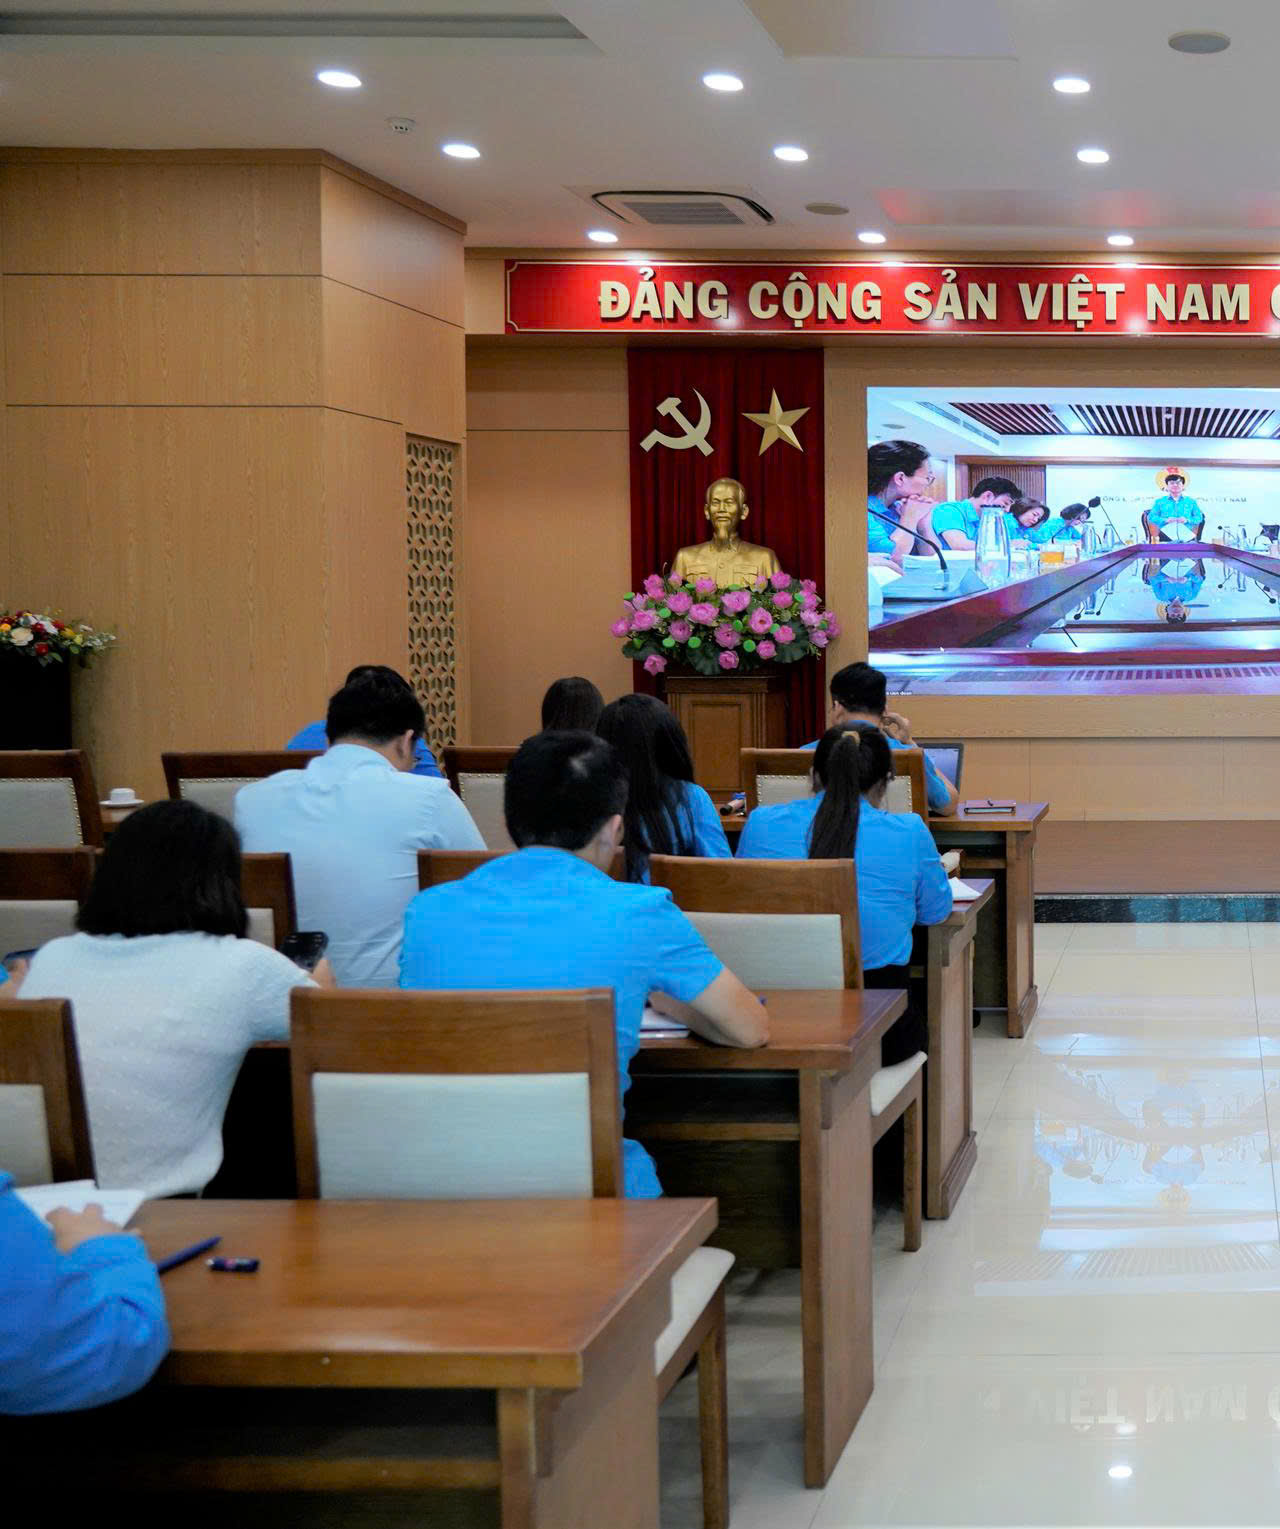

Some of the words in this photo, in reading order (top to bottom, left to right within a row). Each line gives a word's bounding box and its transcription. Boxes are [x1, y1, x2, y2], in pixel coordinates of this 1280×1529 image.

[598, 267, 729, 321] ĐẢNG
[748, 272, 882, 328] CỘNG
[902, 268, 998, 321] SẢN
[1017, 273, 1126, 329] VIỆT
[1146, 282, 1251, 322] NAM
